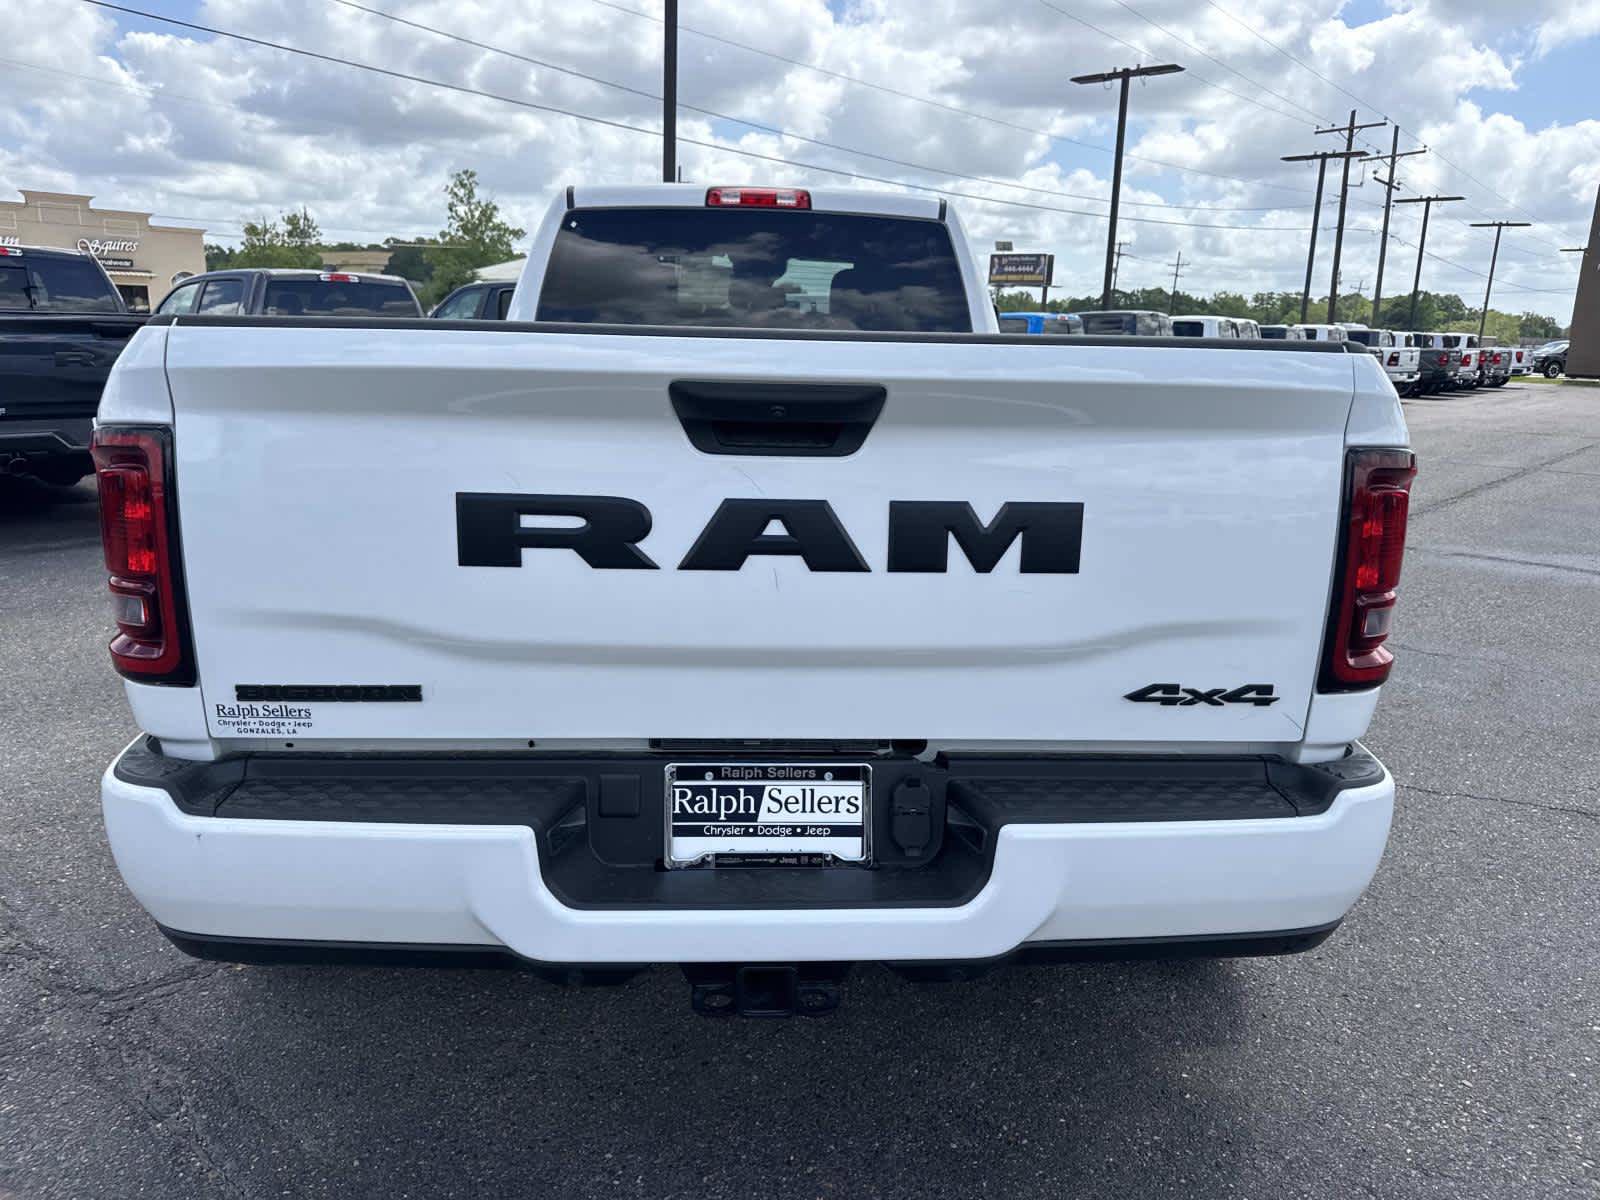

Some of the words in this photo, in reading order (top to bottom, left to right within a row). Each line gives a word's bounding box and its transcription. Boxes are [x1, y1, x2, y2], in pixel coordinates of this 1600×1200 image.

[455, 491, 1084, 574] RAM
[1123, 683, 1281, 706] 4x4
[216, 704, 259, 719] Ralph
[262, 704, 312, 719] Sellers
[217, 720, 251, 728] Chrysler
[259, 720, 286, 728] Dodge
[294, 720, 313, 728] Jeep
[721, 767, 763, 781] Ralph
[767, 767, 816, 779] Sellers
[672, 788, 756, 821] Ralph
[767, 788, 860, 814] Sellers
[703, 825, 745, 837] Chrysler
[757, 825, 793, 836] Dodge
[804, 825, 831, 836] Jeep
